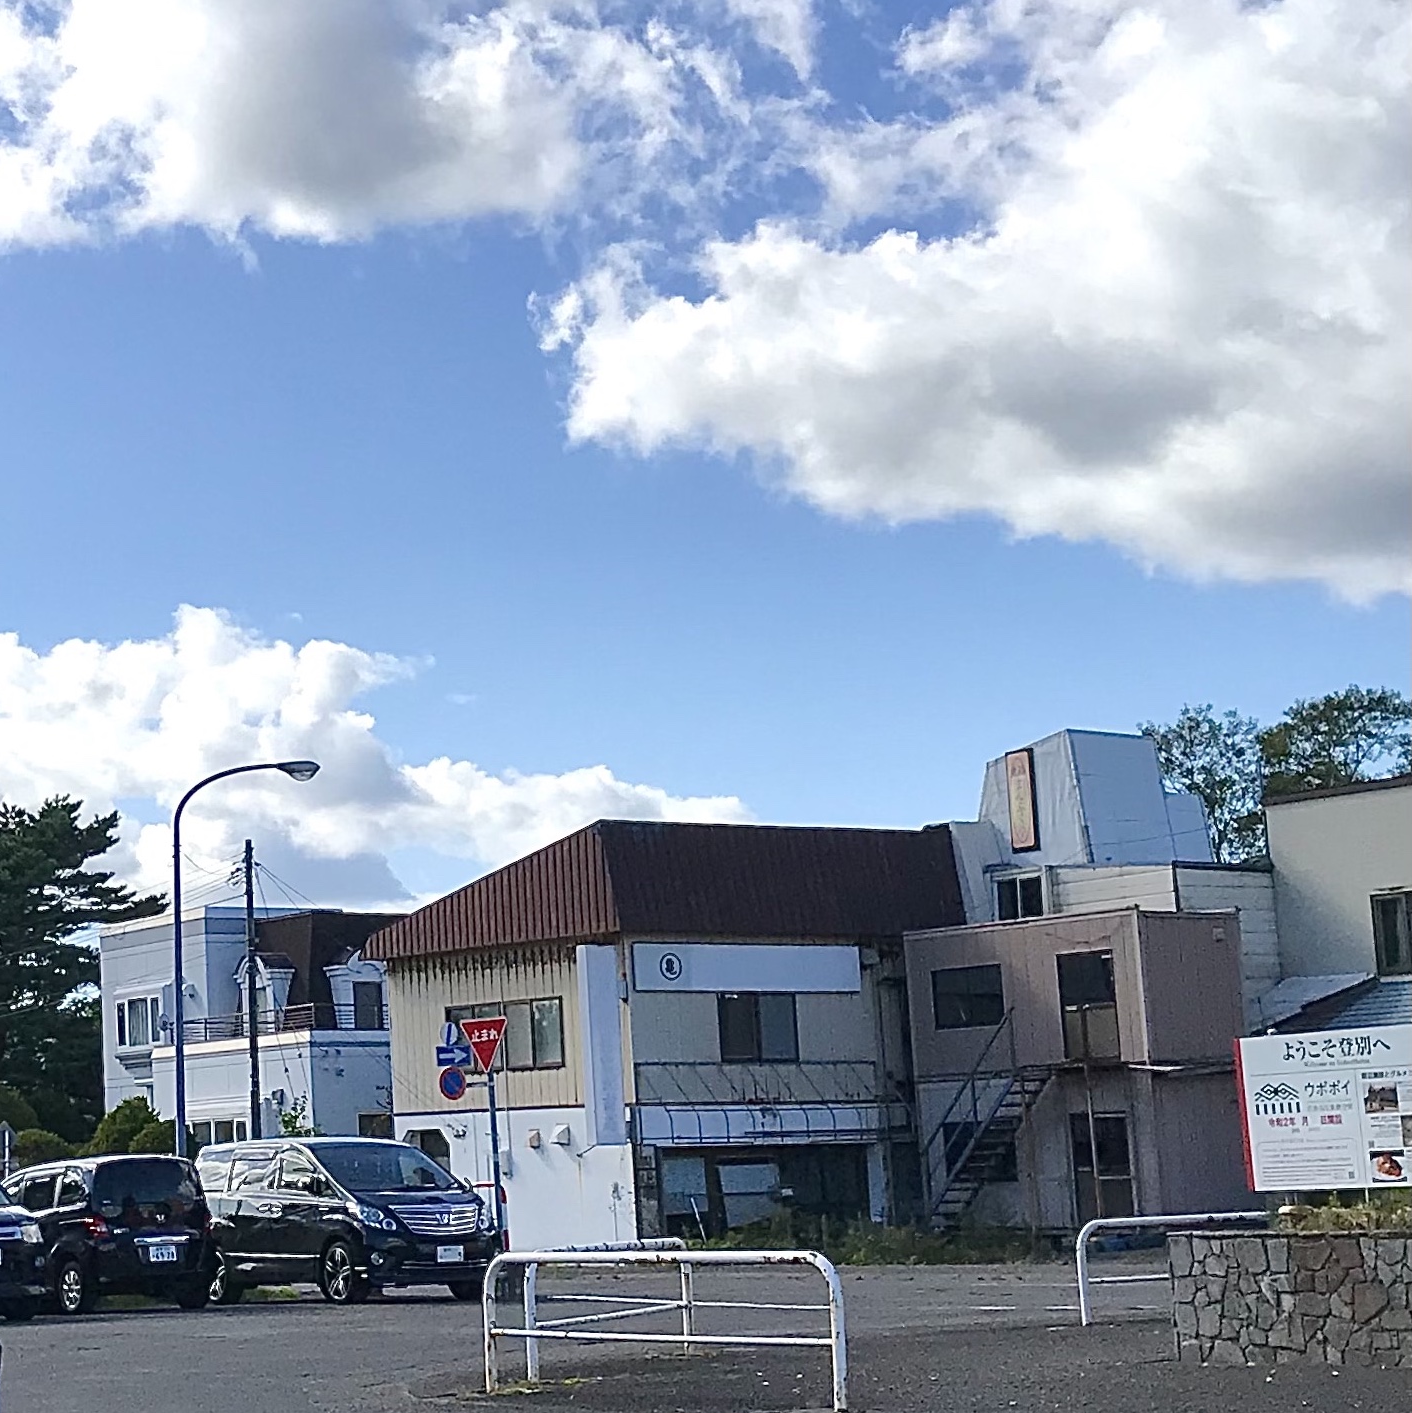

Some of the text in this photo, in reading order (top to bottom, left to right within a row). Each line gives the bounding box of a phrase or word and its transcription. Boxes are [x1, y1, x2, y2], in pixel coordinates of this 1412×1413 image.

[471, 1028, 499, 1043] 止まれ
[1283, 1035, 1391, 1061] ようこそ登別へ
[1304, 1079, 1351, 1098] ウポポイ
